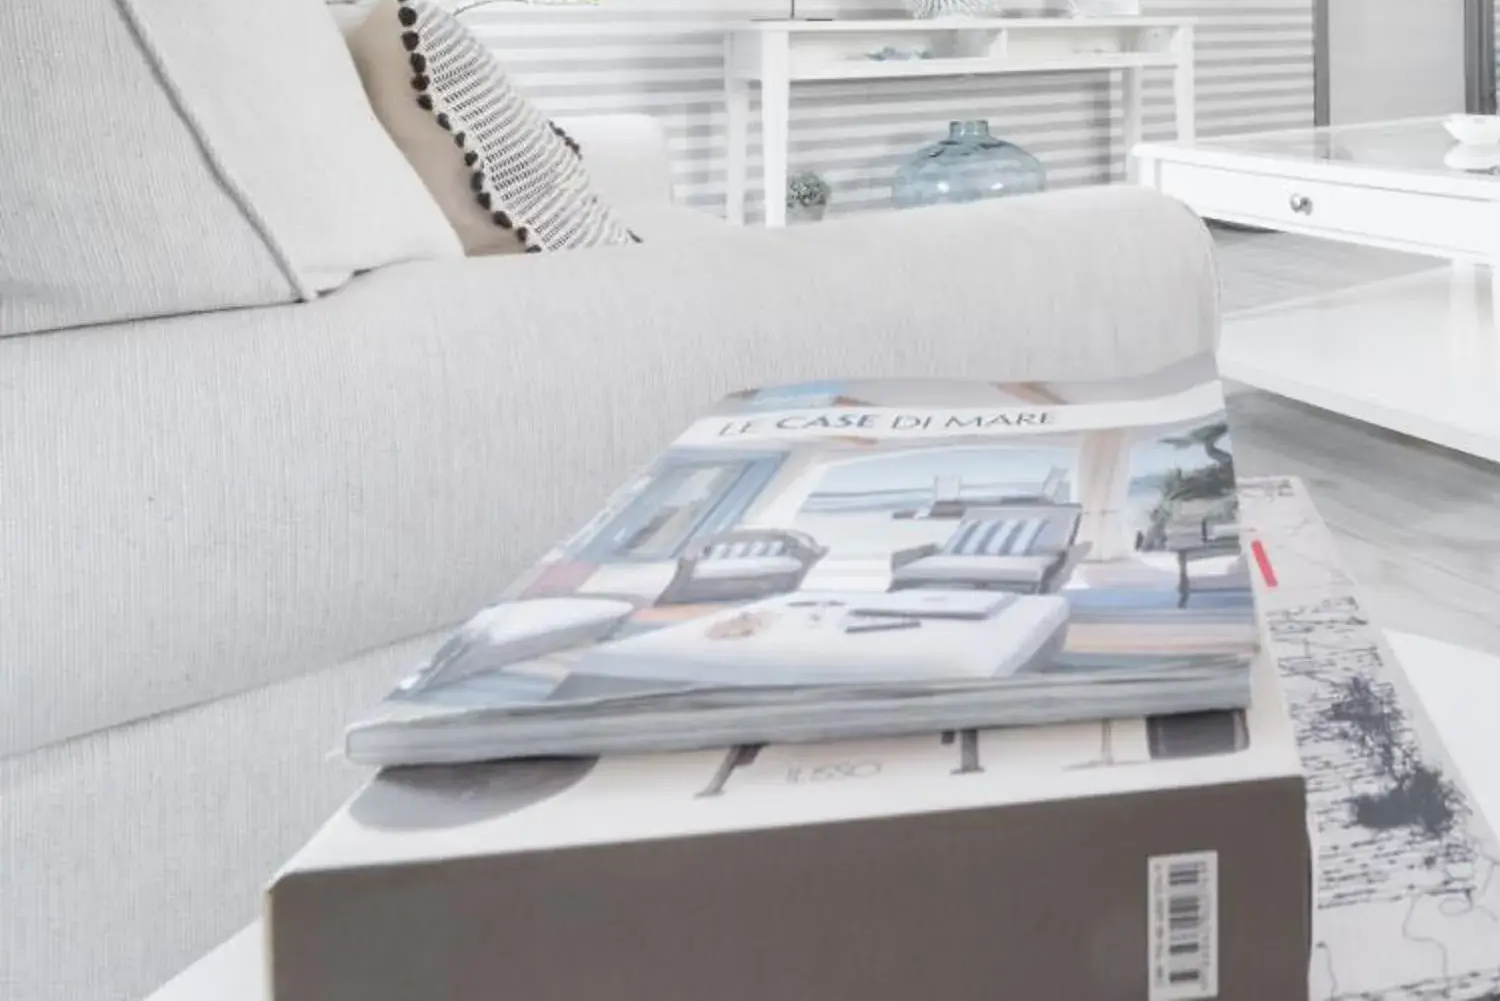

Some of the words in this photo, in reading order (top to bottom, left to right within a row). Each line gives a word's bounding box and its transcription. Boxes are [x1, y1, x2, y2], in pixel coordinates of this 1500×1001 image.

[718, 419, 757, 437] LE
[775, 413, 881, 430] CASE
[891, 414, 933, 430] DI
[944, 410, 1056, 429] MARE
